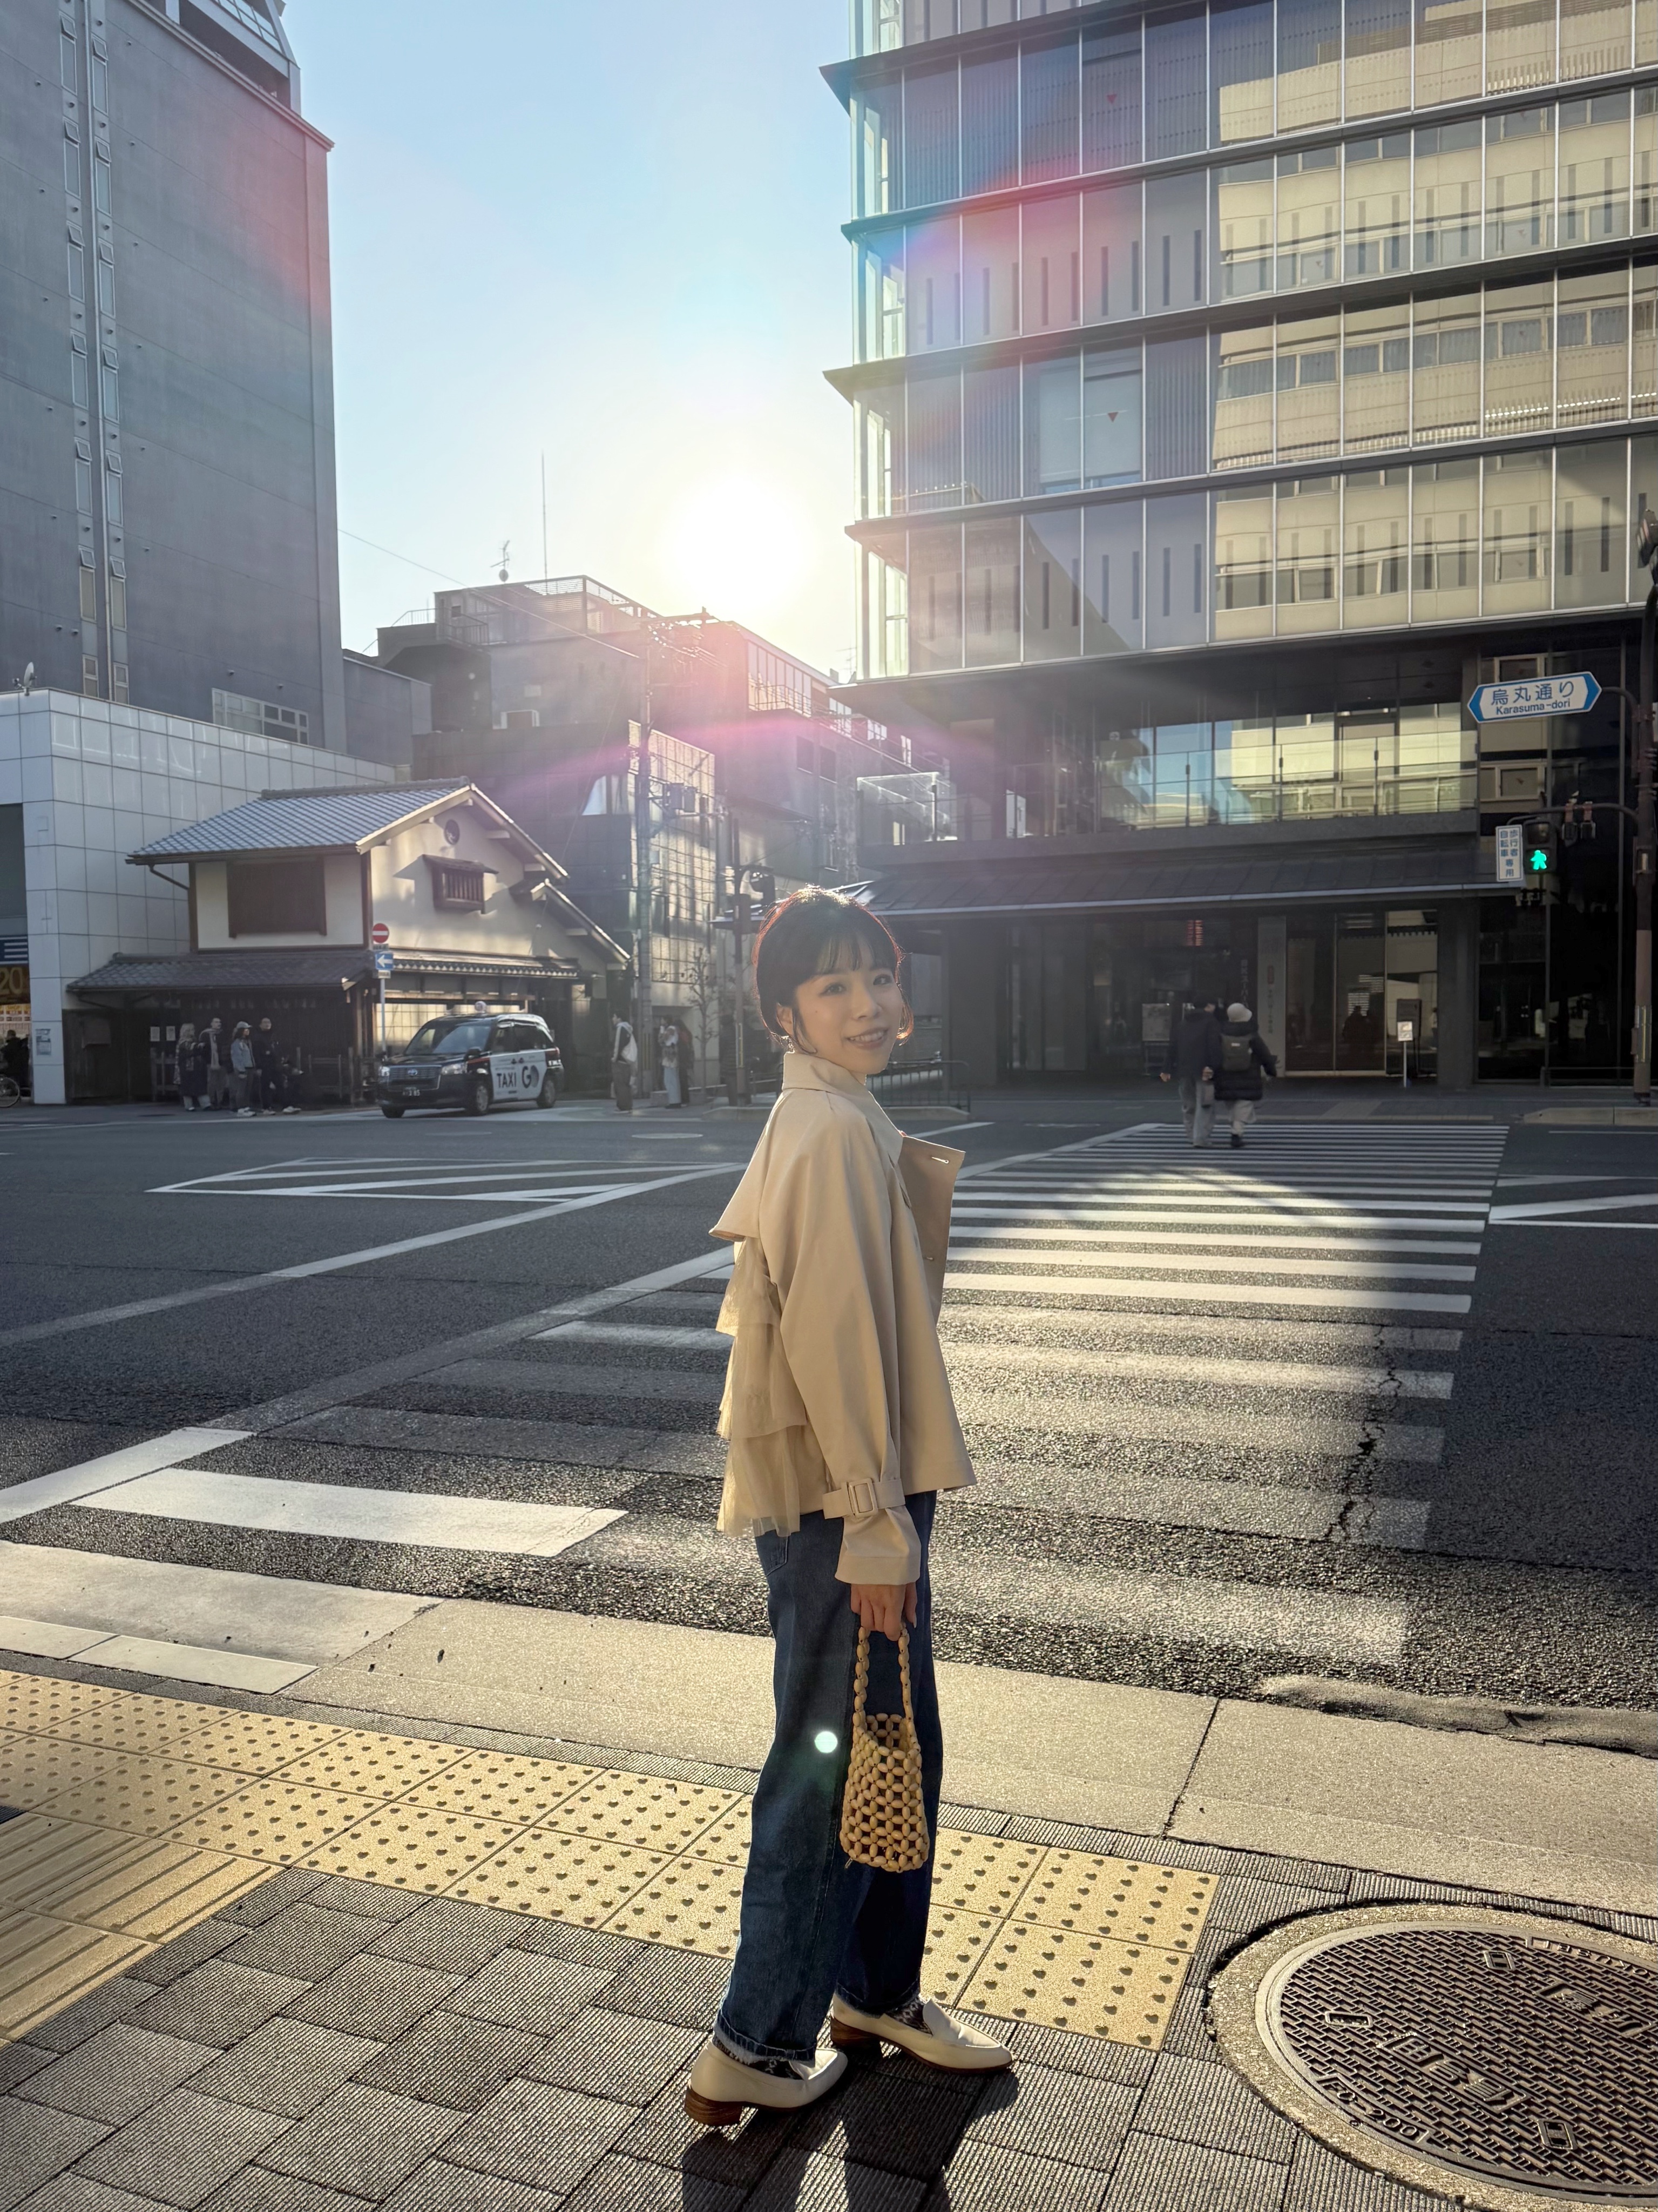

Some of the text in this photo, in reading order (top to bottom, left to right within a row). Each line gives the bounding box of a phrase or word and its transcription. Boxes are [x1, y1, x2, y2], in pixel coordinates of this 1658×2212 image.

[1491, 680, 1574, 705] 烏丸通り
[1496, 698, 1571, 715] Karasuma-dori
[1500, 831, 1508, 857] 自転車
[1510, 830, 1518, 857] 歩行者
[496, 1065, 539, 1089] TAXI GO
[1545, 1940, 1655, 1979] OKUSEI
[1553, 1991, 1643, 2028] 府警
[1392, 2038, 1513, 2101] 信号用
